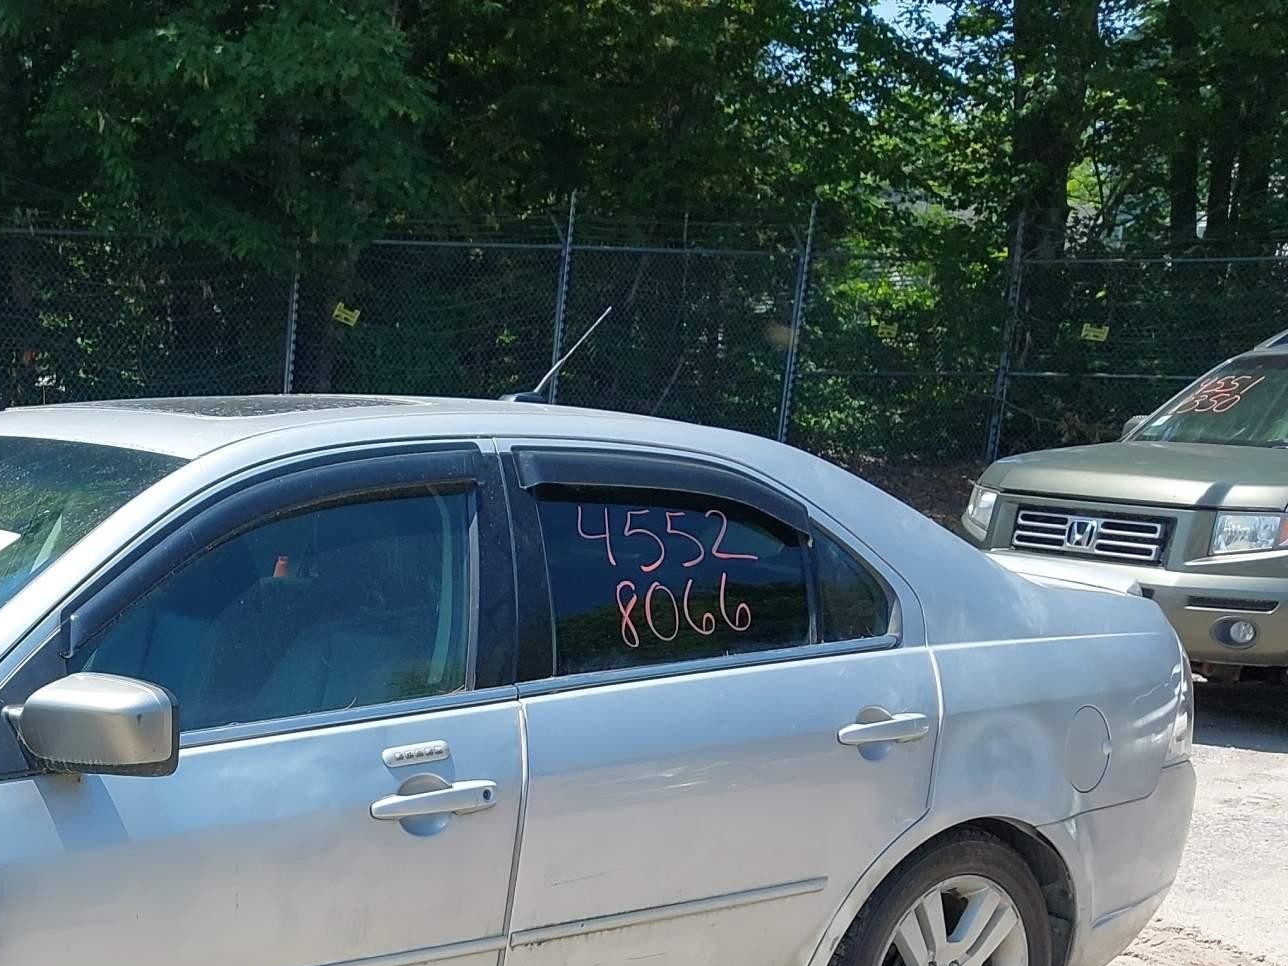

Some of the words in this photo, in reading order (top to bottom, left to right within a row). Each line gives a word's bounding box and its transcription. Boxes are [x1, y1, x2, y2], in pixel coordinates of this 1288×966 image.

[1195, 376, 1266, 395] 4551
[577, 505, 759, 573] 4552
[615, 571, 752, 648] 8066
